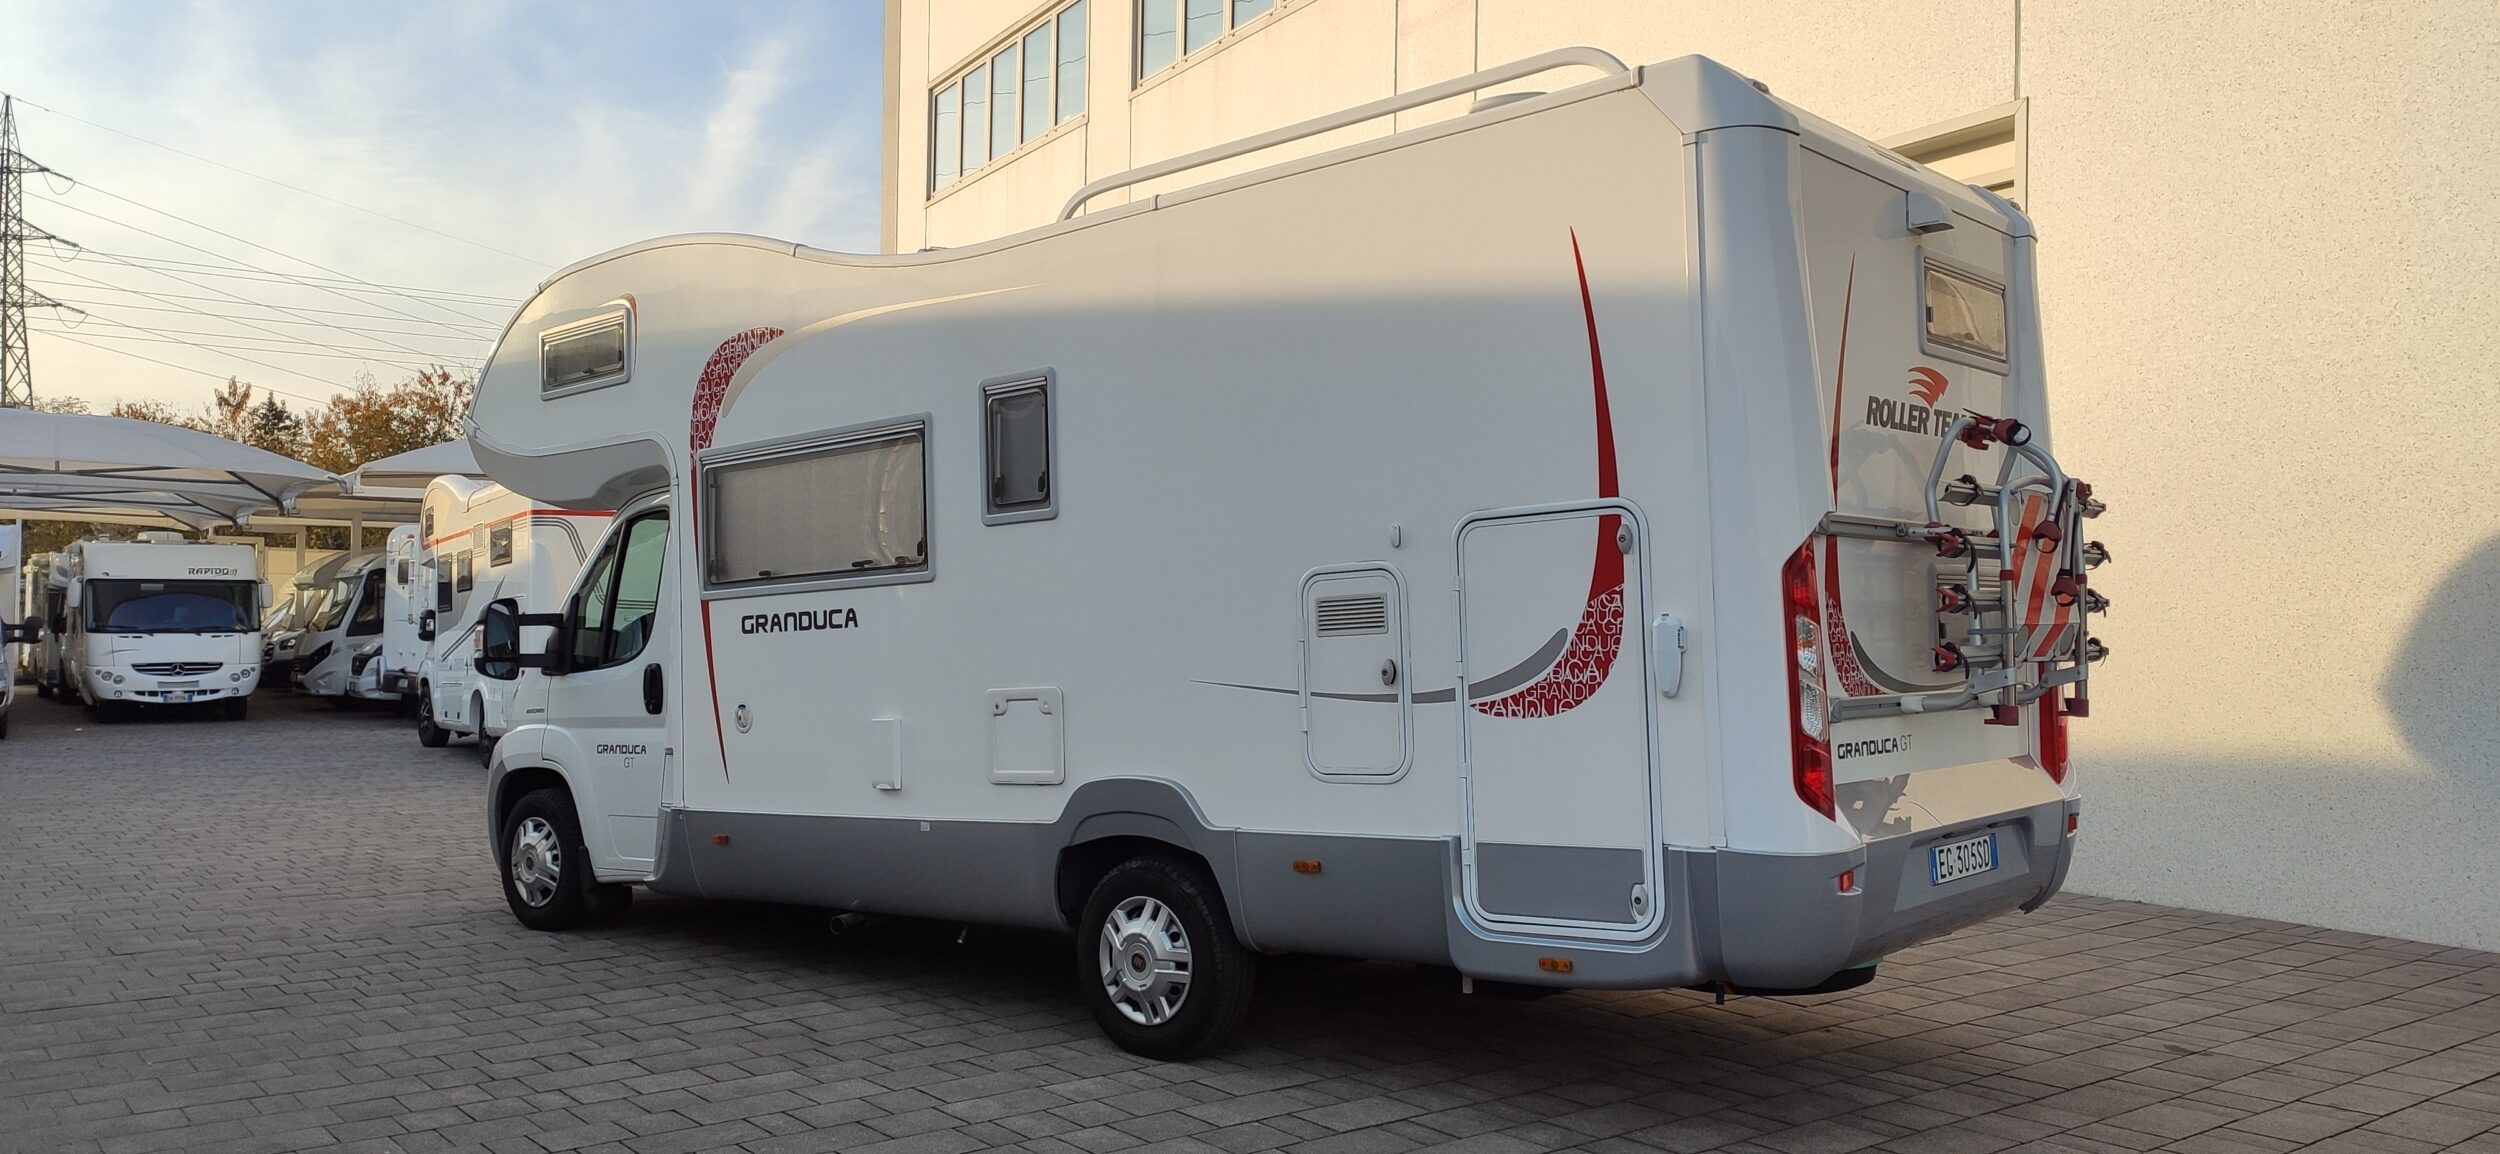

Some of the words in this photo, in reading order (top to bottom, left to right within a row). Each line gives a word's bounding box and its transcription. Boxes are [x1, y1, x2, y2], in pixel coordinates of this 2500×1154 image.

[1866, 395, 1931, 435] ROLLER
[187, 567, 230, 576] RAPIDO
[741, 607, 859, 635] GRANDUCA
[596, 744, 647, 754] GRANDUCA
[1837, 737, 1899, 760] GRANDUCA
[1900, 734, 1913, 752] GT
[623, 757, 635, 768] GT
[1938, 847, 1953, 879] EG
[1956, 839, 1990, 874] 305SD
